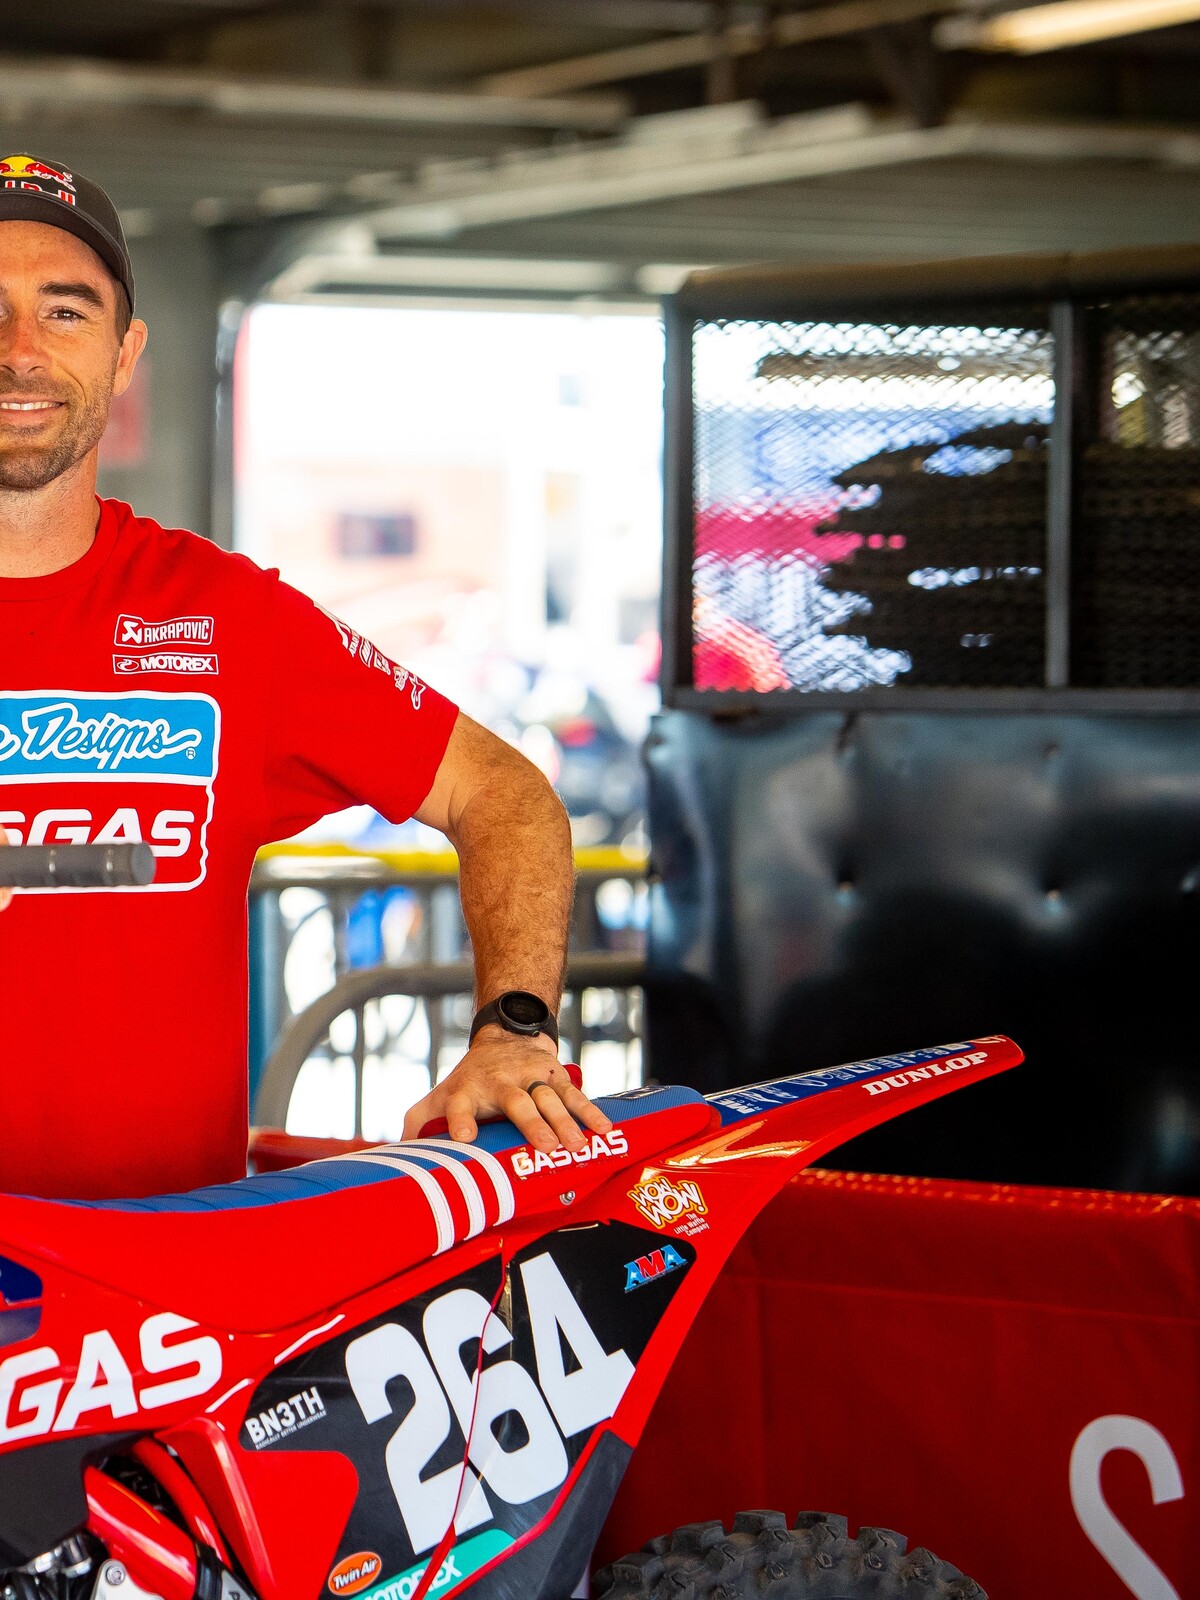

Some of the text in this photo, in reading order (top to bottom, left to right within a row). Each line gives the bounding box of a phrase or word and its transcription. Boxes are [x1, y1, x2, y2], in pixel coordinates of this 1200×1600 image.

[144, 620, 209, 643] AKRAPOVIČ
[140, 656, 214, 671] MOTOREX
[21, 702, 202, 769] Designs
[862, 1052, 988, 1095] DUNLOP
[511, 1130, 628, 1176] GASGAS
[631, 1179, 672, 1207] WOW
[624, 1245, 687, 1290] AMA
[245, 1386, 325, 1444] BN3TH
[345, 1252, 636, 1555] 264
[332, 1558, 380, 1590] Twin Air
[365, 1555, 463, 1600] TOEX
